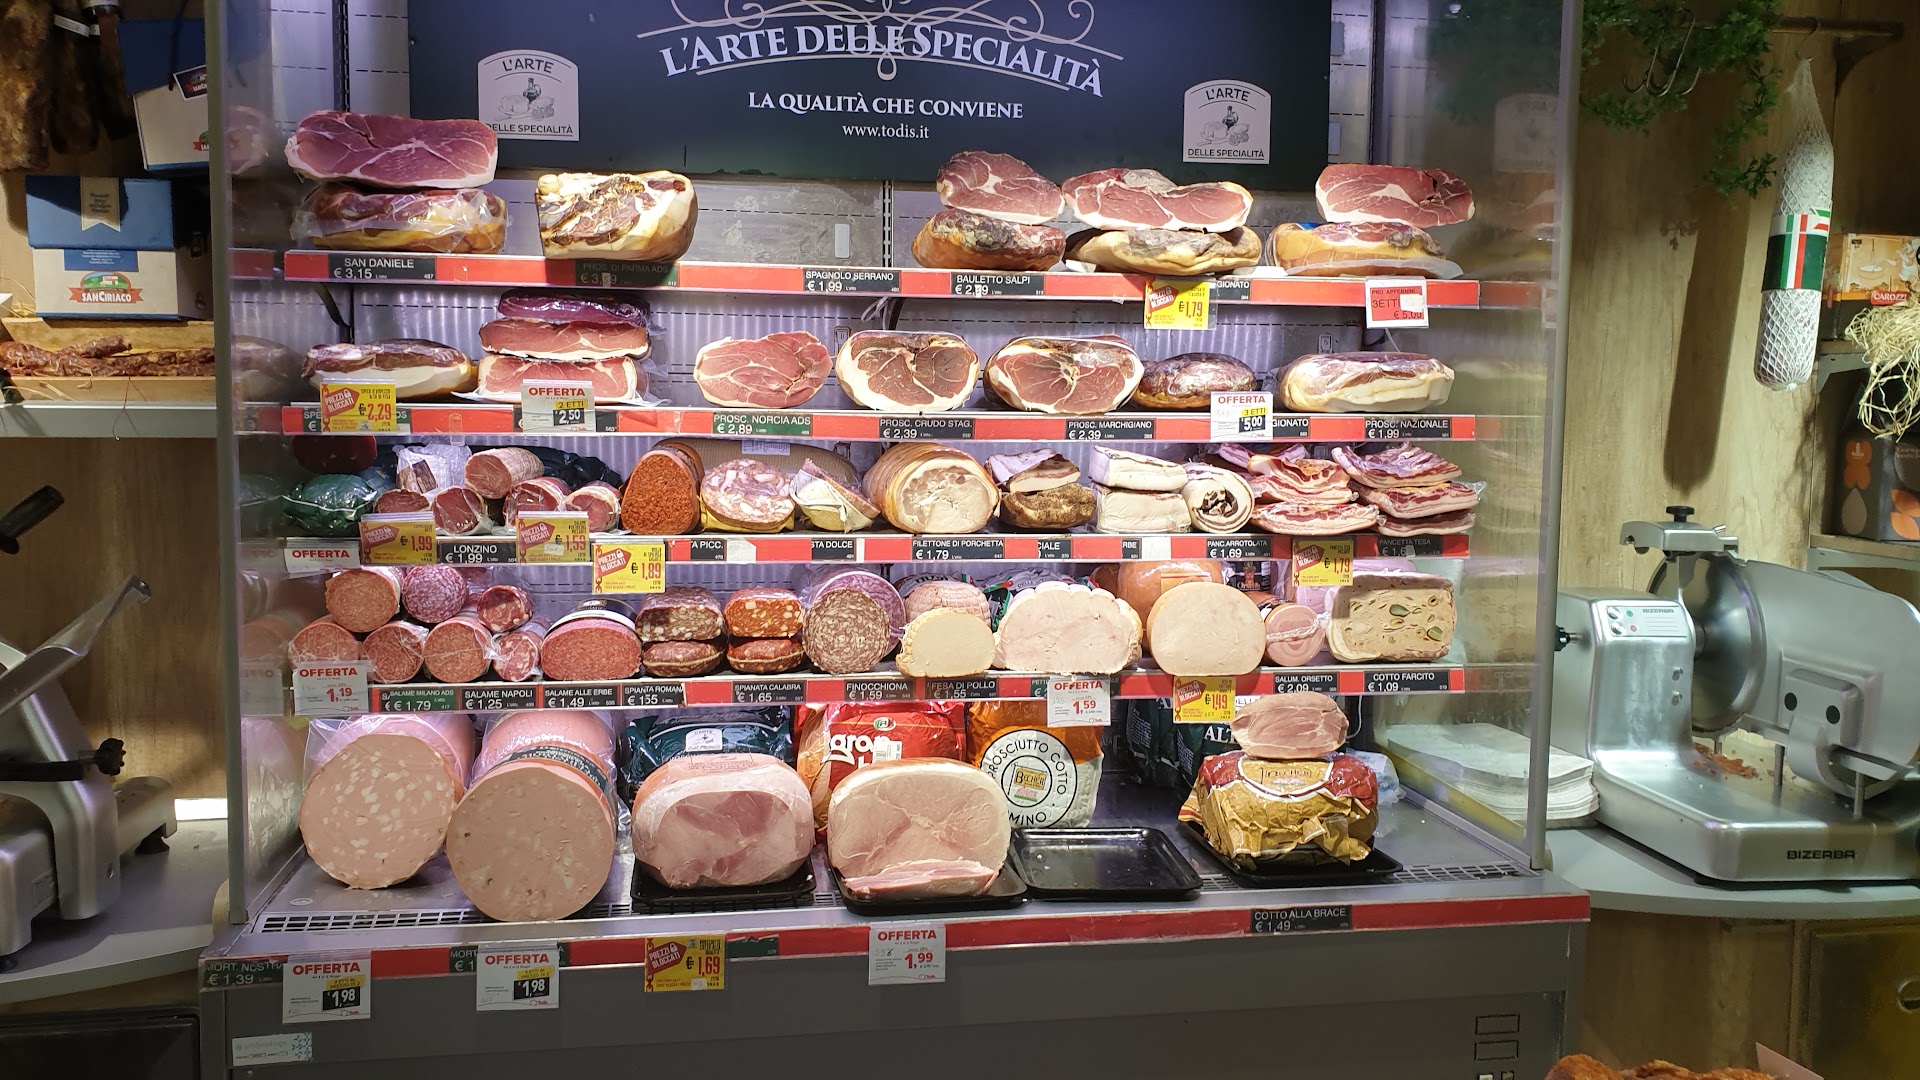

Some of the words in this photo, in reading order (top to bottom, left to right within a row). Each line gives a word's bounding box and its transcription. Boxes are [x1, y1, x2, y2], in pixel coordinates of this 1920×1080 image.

[502, 58, 554, 74] L'ARTE
[659, 27, 788, 77] L'ARTE
[794, 24, 905, 54] DELLE
[912, 24, 1103, 98] SPECIALITÀ
[1206, 87, 1251, 102] L'ARTE
[748, 92, 776, 109] LA
[779, 91, 870, 115] QUALITÀ
[872, 97, 915, 115] CHE
[918, 99, 1024, 119] CONVIENE
[518, 123, 573, 134] SPECIALITÀ
[842, 123, 930, 139] www.todis.it
[1188, 148, 1215, 157] DELLE
[1216, 148, 1265, 158] SPECIALITÀ
[344, 258, 366, 267] SAN
[369, 258, 414, 268] DANIELE
[611, 264, 620, 272] DI
[621, 264, 650, 272] PARMA
[345, 268, 372, 279] 3,15
[806, 271, 851, 280] SPAGNOLO
[853, 272, 894, 281] SERRANO
[957, 275, 1003, 284] BAULETTO
[1005, 275, 1031, 284] SALPI
[818, 281, 842, 292] 1,99
[1148, 289, 1166, 300] PREZZI
[1873, 293, 1907, 301] CAROZZI
[1150, 295, 1174, 308] BLOCCATI
[1186, 301, 1202, 318] 1,79
[528, 387, 585, 396] OFFERTA
[325, 393, 344, 405] PREZZI
[328, 397, 354, 412] BLOCCATI
[566, 400, 584, 408] ETTI
[1218, 395, 1265, 404] OFFERTA
[367, 403, 392, 421] 2,29
[558, 409, 580, 424] 2,50
[1250, 407, 1266, 415] ETTI
[714, 415, 749, 423] PROSC.
[752, 415, 790, 424] NORCIA
[791, 416, 811, 425] ADS
[880, 419, 912, 427] PROSC.
[914, 419, 946, 427] CRUDO
[947, 420, 972, 428] STAG.
[1068, 421, 1097, 429] PROSC.
[1098, 421, 1152, 429] MARCHIGIANO
[1243, 416, 1262, 431] 5,00
[1365, 420, 1398, 428] PROSC.
[1400, 420, 1448, 428] NAZIONALE
[728, 424, 752, 434] 2,89
[893, 428, 917, 439] 2,39
[1378, 429, 1400, 439] 1,99
[1078, 430, 1101, 440] 2,39
[365, 528, 384, 539] PREZZI
[521, 525, 541, 537] PREZZI
[524, 530, 550, 543] BLOCCATI
[368, 532, 394, 543] BLOCCATI
[410, 535, 432, 552] 1,99
[565, 535, 586, 552] 1,59
[700, 541, 723, 549] PICC.
[825, 541, 853, 549] DOLCE
[292, 550, 350, 558] OFFERTA
[453, 545, 497, 554] LONZINO
[926, 550, 949, 560] 1,79
[1220, 548, 1242, 559] 1,69
[458, 553, 482, 563] 1,99
[597, 552, 617, 564] PREZZI
[600, 557, 626, 572] BLOCCATI
[1333, 557, 1350, 574] 1,79
[641, 562, 661, 580] 1,89
[299, 667, 358, 677] OFFERTA
[1373, 673, 1400, 681] COTTO
[1275, 675, 1299, 683] SALUM.
[769, 683, 801, 691] CALABRA
[846, 683, 908, 691] FINOCCHIONA
[955, 682, 964, 690] DI
[966, 681, 995, 689] POLLO
[1054, 680, 1103, 690] OFFERTA
[1287, 683, 1309, 692] 2,09
[1377, 682, 1399, 692] 1,09
[326, 687, 353, 702] 1,19
[465, 690, 499, 699] SALAME
[502, 690, 533, 698] NAPOLI
[749, 692, 772, 703] 1,65
[860, 690, 882, 700] 1,59
[944, 689, 966, 699] 1,55
[1179, 689, 1201, 702] BLOCCATI
[406, 700, 431, 711] 1,79
[477, 699, 502, 710] 1,25
[560, 697, 584, 708] 1,49
[1072, 700, 1096, 714] 1,59
[1211, 693, 1227, 710] 1,49
[987, 739, 1049, 779] PROSCIUTTO
[1050, 752, 1068, 795] COTTO
[1786, 849, 1856, 860] BIZERBA
[1254, 911, 1287, 920] COTTO
[1288, 909, 1312, 919] ALLA
[1313, 908, 1346, 918] BRACE
[1267, 920, 1290, 932] 1,49
[877, 930, 937, 941] OFFERTA
[649, 946, 670, 960] PREZZI
[485, 953, 550, 965] OFFERTA
[652, 952, 680, 968] BLOCCATI
[904, 952, 933, 969] 1,99
[292, 962, 360, 975] OFFERTA
[697, 956, 720, 976] 1,69
[224, 973, 254, 986] 1,39
[522, 978, 545, 997] 1,98
[331, 989, 356, 1007] 1,98
